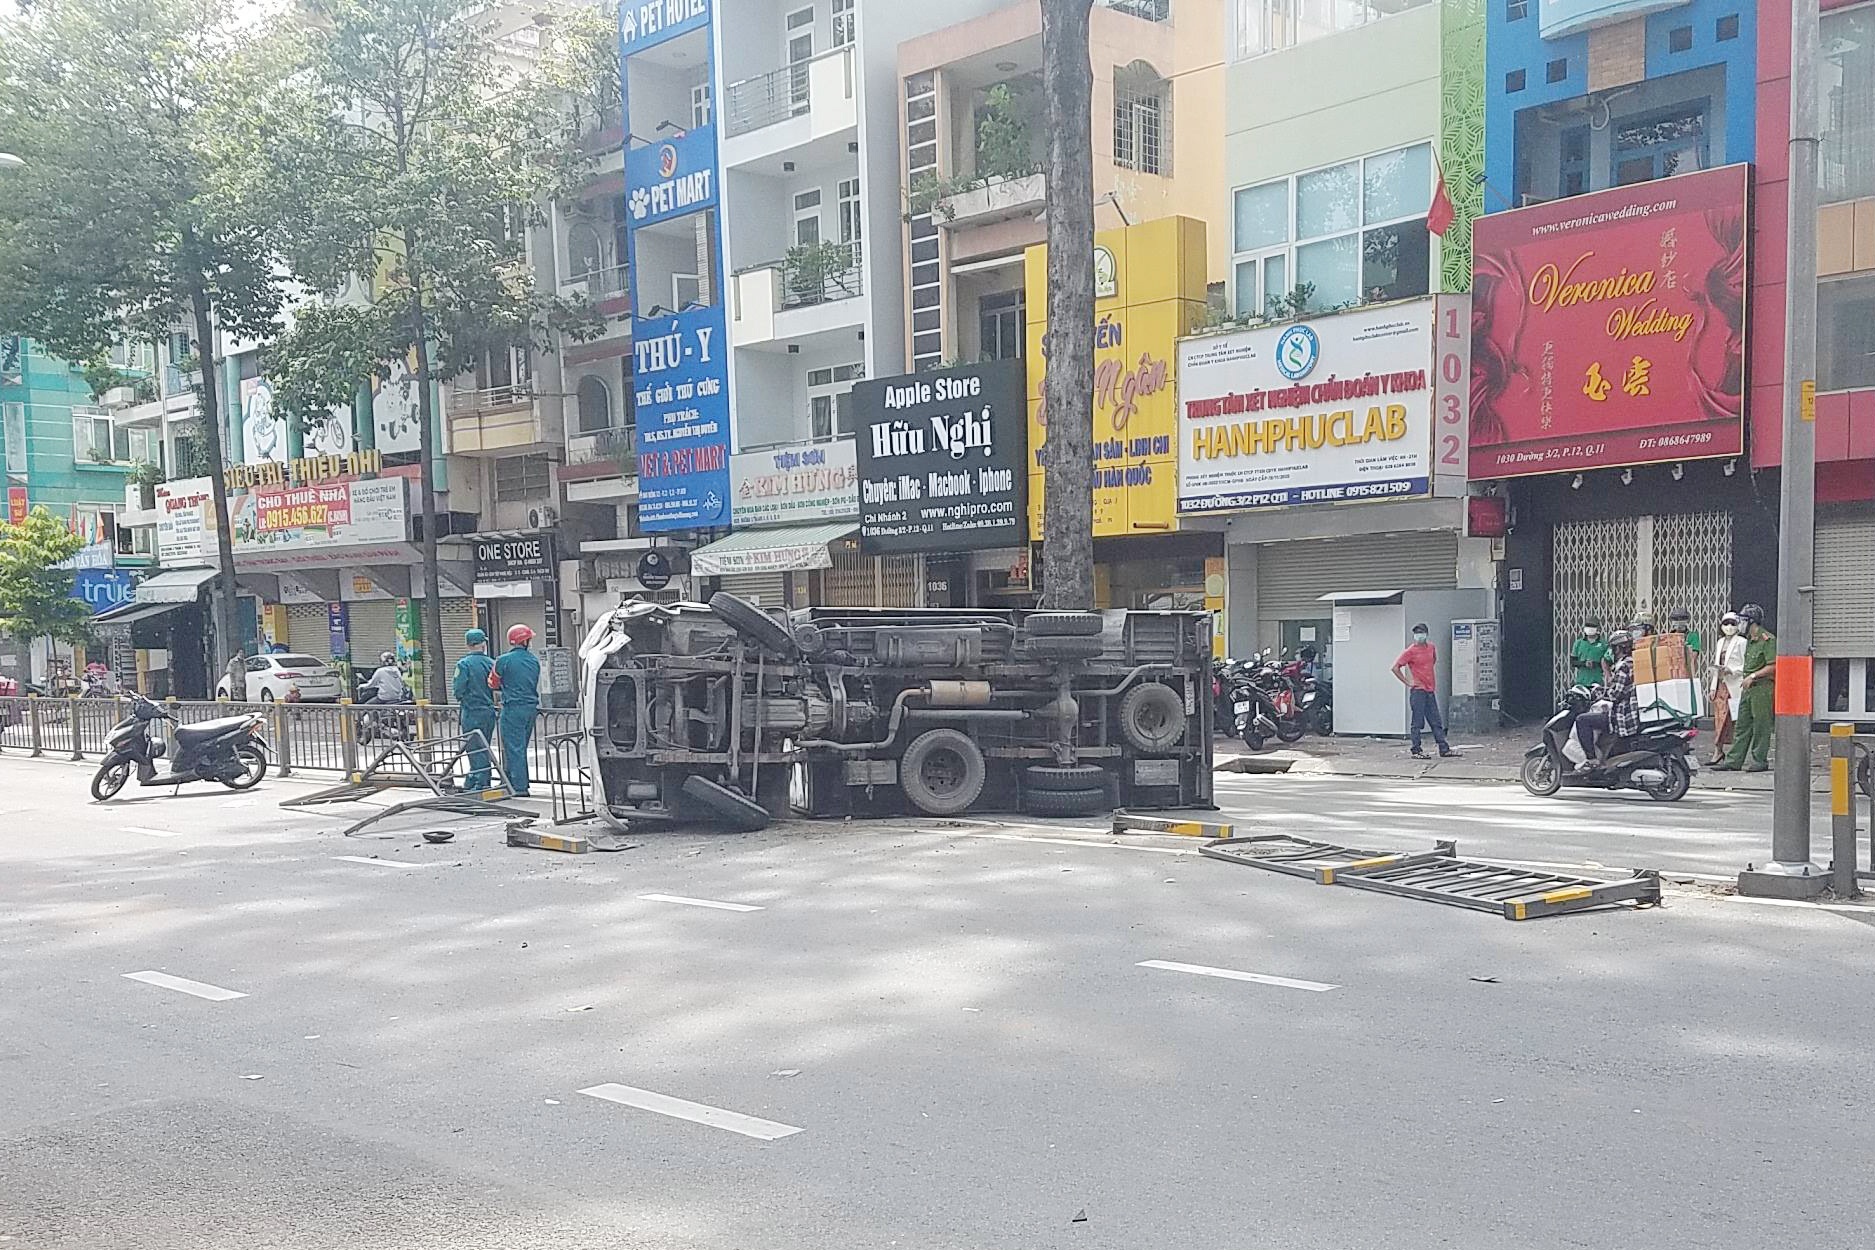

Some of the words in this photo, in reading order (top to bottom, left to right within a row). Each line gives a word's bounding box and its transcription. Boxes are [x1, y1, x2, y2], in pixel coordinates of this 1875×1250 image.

[641, 0, 663, 37] PET
[651, 180, 675, 215] PET
[676, 169, 711, 208] MART
[1532, 200, 1677, 236] www.veronicawedding.com
[1529, 251, 1657, 313] Veronica
[1606, 298, 1694, 342] Wedding
[635, 319, 682, 374] THÚ
[696, 327, 713, 363] Y
[636, 382, 653, 406] THẾ
[676, 378, 694, 400] THÚ
[884, 381, 932, 410] Apple
[935, 376, 982, 402] Store
[1094, 352, 1168, 431] Ngân
[1185, 398, 1221, 419] TRUNG
[1223, 392, 1244, 415] TÂM
[1245, 388, 1267, 412] XÉT
[1268, 383, 1310, 409] NGHIỆM
[1380, 374, 1391, 395] Y
[1391, 369, 1426, 394] KHOA
[869, 419, 926, 459] Hữu
[1129, 437, 1151, 457] LINH
[1152, 435, 1170, 455] CHI
[1192, 403, 1408, 461] HANHPHUCLAB
[641, 449, 660, 479] VET
[672, 448, 693, 476] PET
[694, 443, 726, 472] MART
[1496, 454, 1516, 465] 1030
[1516, 451, 1545, 462] Đường
[1585, 443, 1605, 457] Q.11
[223, 462, 255, 490] SIÊU
[754, 474, 789, 498] KIM
[789, 467, 846, 495] HƯNG
[898, 475, 921, 501] iMac
[928, 469, 971, 498] Macbook
[979, 466, 1012, 496] Iphone
[1125, 460, 1152, 487] QUỐC
[258, 495, 282, 510] CHO
[285, 488, 316, 506] THUÊ
[319, 486, 347, 502] NHÀ
[920, 501, 1013, 519] www.nghipro.com
[1181, 500, 1201, 511] 1032
[1201, 494, 1237, 509] ĐƯỜNG
[1237, 495, 1253, 506] 3/2
[1253, 494, 1270, 505] P12
[1301, 487, 1345, 500] HOTLINE
[266, 505, 328, 528] 0915.456.627
[478, 543, 501, 561] ONE
[503, 540, 541, 560] STORE
[82, 578, 136, 603] true
[927, 581, 948, 592] 1036
